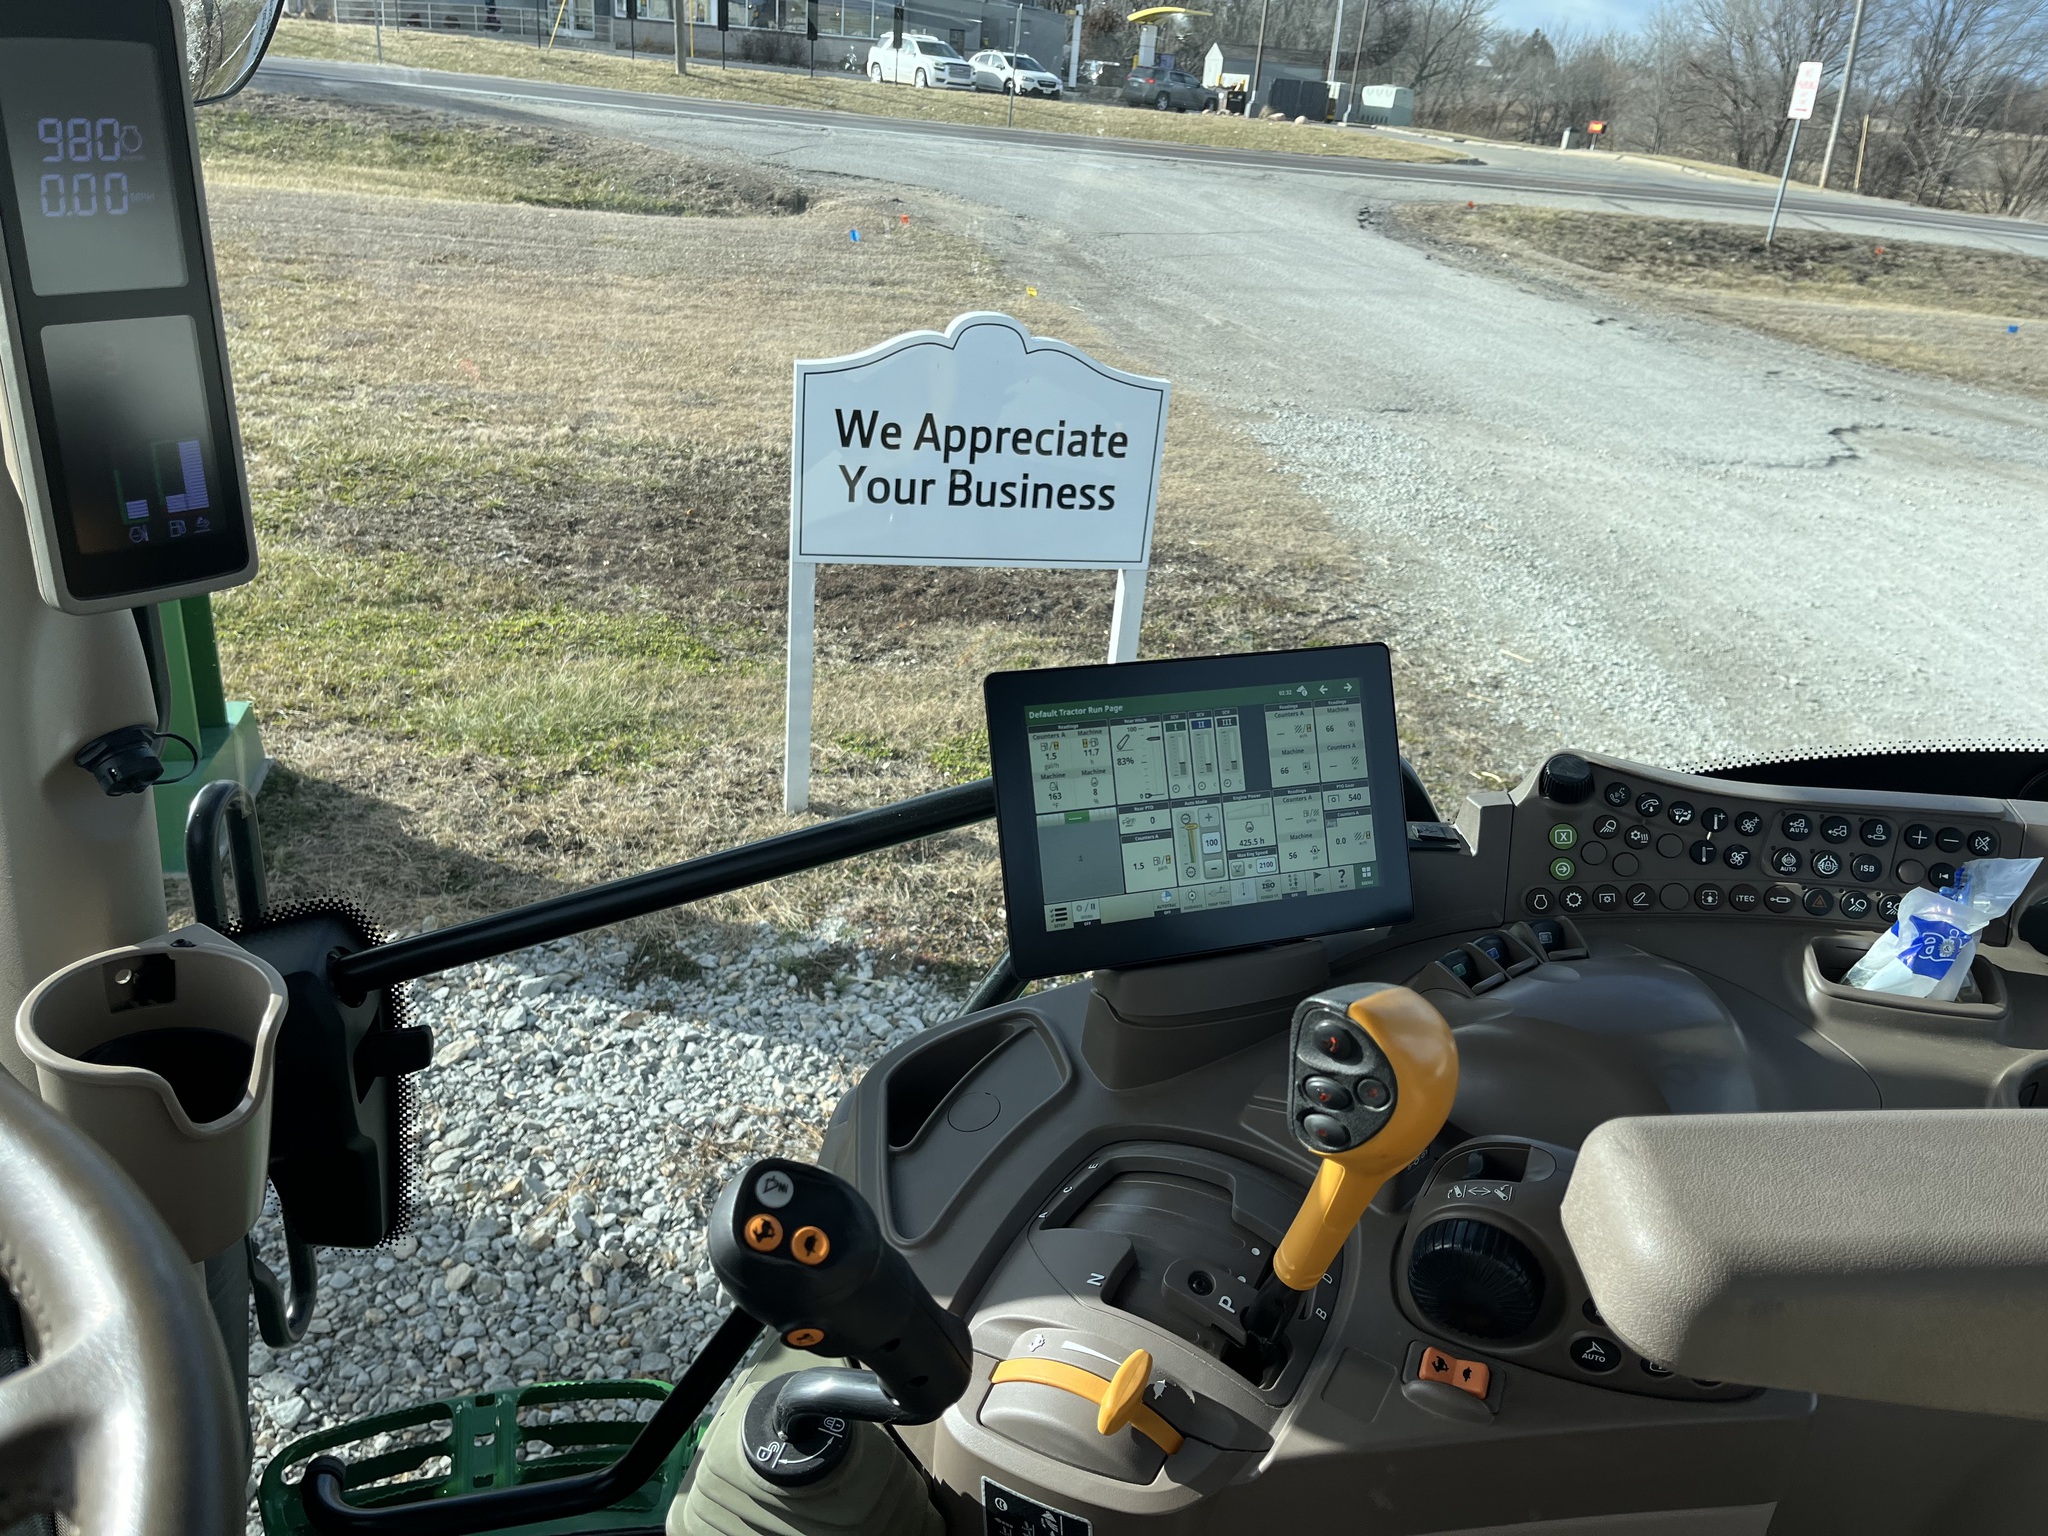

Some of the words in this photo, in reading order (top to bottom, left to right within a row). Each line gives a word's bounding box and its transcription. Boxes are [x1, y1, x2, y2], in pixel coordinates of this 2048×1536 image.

[38, 117, 120, 162] 980
[41, 172, 128, 217] 0.00
[834, 408, 902, 450] We
[913, 412, 1128, 464] Appreciate
[838, 464, 936, 505] Your
[947, 469, 1116, 510] Business
[1028, 710, 1058, 719] Default
[1059, 707, 1087, 716] Tractor
[1088, 706, 1103, 714] Run
[1104, 705, 1123, 714] Page
[1274, 711, 1298, 719] Counters
[1222, 718, 1232, 726] III
[1032, 733, 1060, 741] Counters
[1327, 743, 1351, 751] Counters
[1084, 749, 1099, 757] 11.7
[1117, 757, 1135, 766] 83%
[1081, 768, 1106, 776] Machine
[1280, 767, 1289, 775] 66
[1040, 772, 1066, 780] Machine
[1048, 792, 1062, 800] 163
[1283, 796, 1307, 804] Counters
[1348, 793, 1362, 802] 540
[1150, 816, 1155, 824] 0
[1205, 839, 1218, 847] 100
[1239, 838, 1258, 847] 425.5
[1335, 837, 1347, 845] 0.0
[1288, 852, 1298, 860] 56
[1133, 862, 1145, 870] 1.5
[1259, 861, 1274, 869] 2100
[1860, 864, 1875, 872] ISB
[1735, 894, 1755, 902] iTEC
[1086, 1272, 1105, 1286] N
[1322, 1272, 1333, 1285] D
[1218, 1295, 1236, 1314] P
[1315, 1307, 1327, 1320] B
[1581, 1352, 1606, 1363] AUTO
